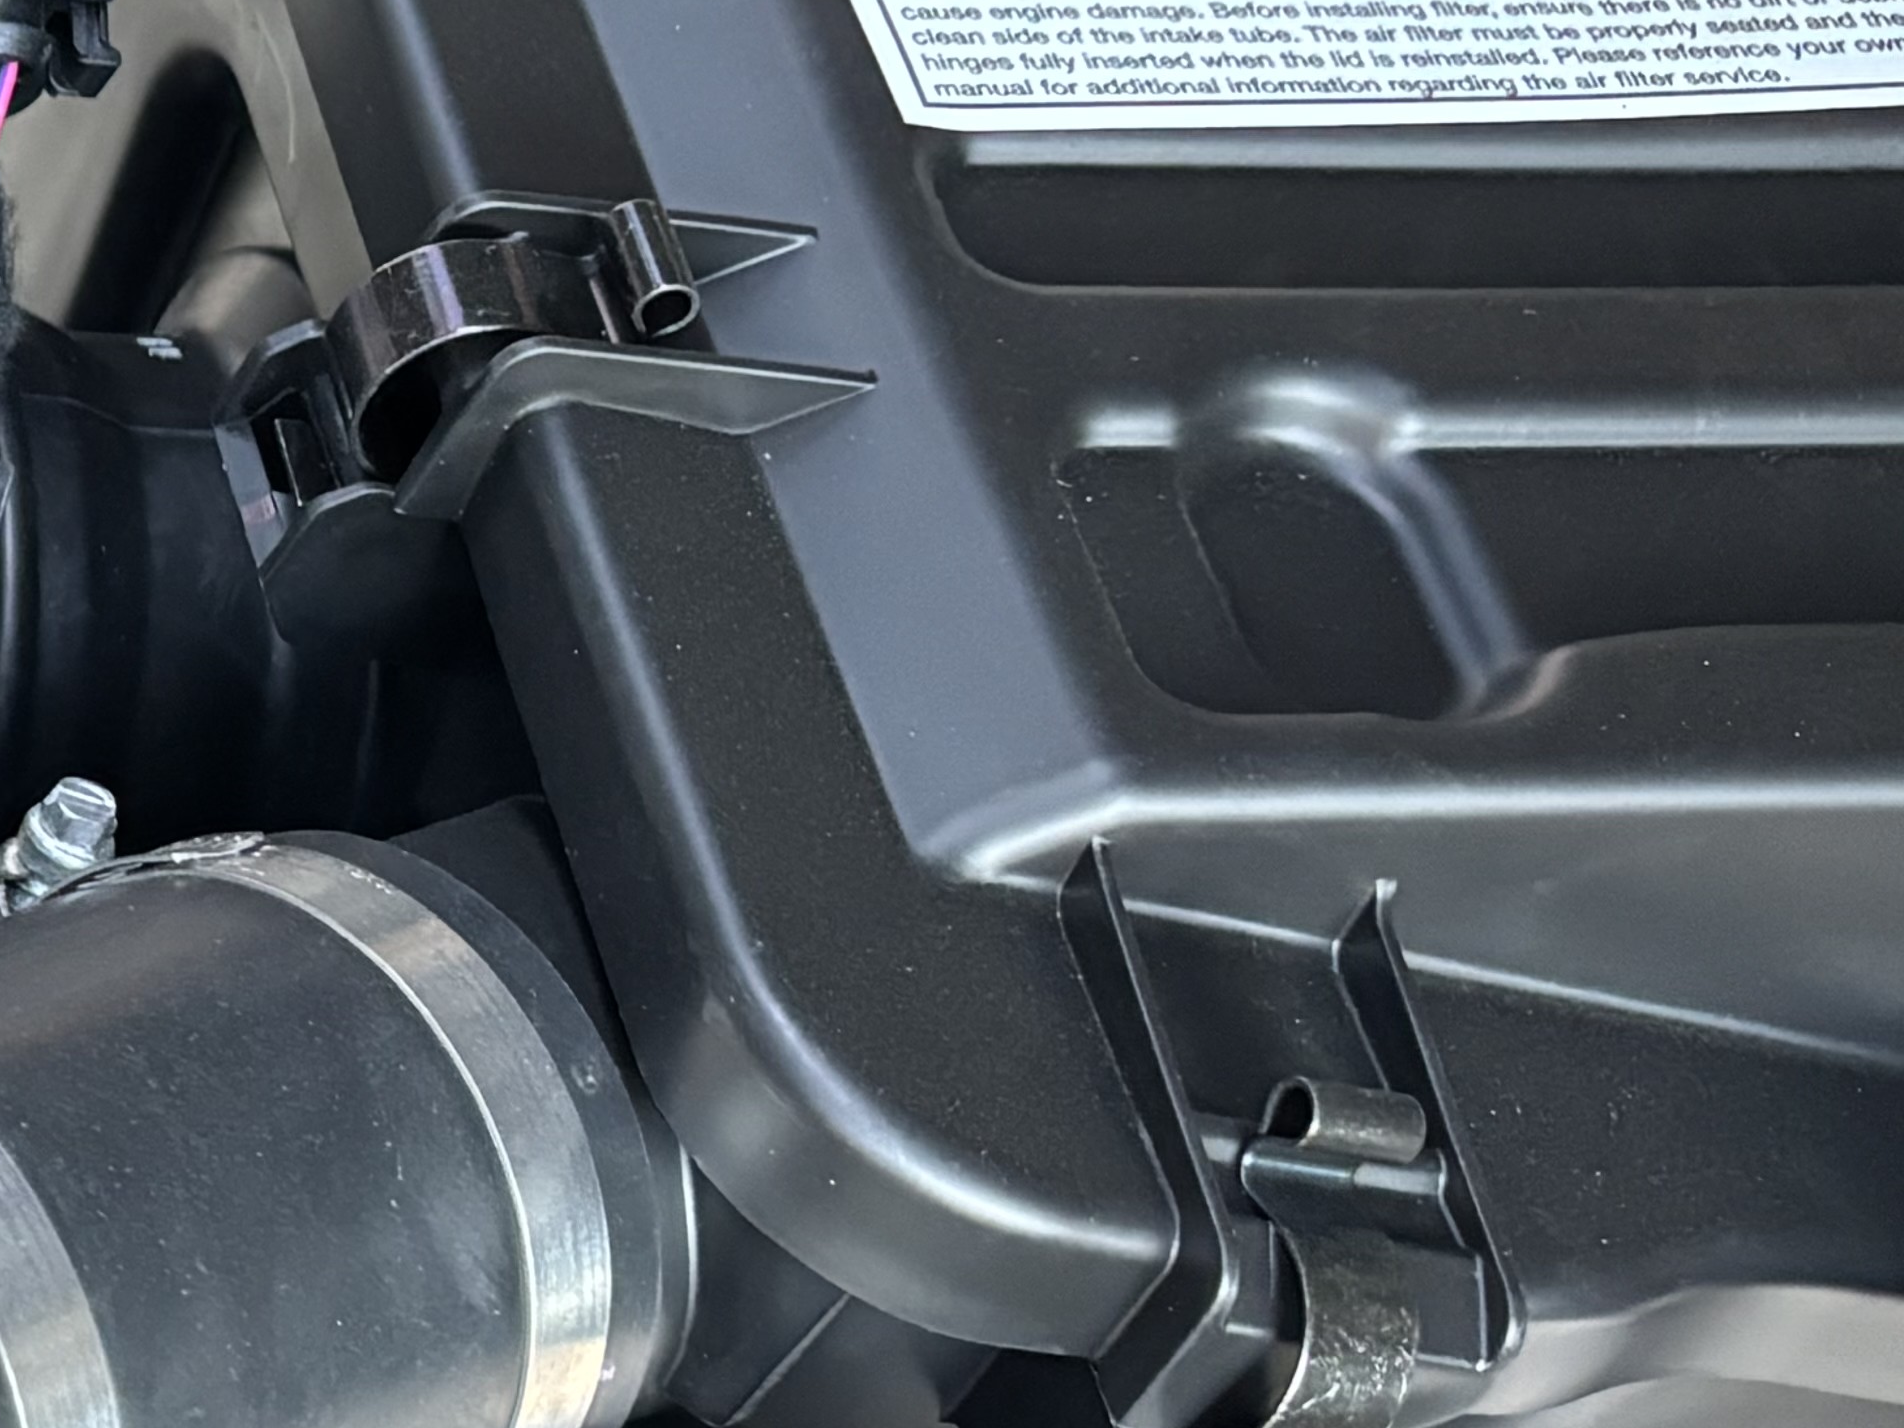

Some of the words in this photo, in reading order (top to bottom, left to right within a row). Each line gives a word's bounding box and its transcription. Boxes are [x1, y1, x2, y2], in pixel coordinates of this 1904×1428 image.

[901, 4, 982, 21] cause
[989, 3, 1080, 23] engine
[1087, 2, 1204, 23] damage.
[1208, 1, 1300, 19] Before
[1305, 0, 1426, 21] installing
[1431, 0, 1498, 19] filter,
[1504, 0, 1593, 17] ensure
[912, 28, 986, 46] clean
[992, 28, 1049, 45] side
[1057, 27, 1084, 44] of
[1091, 27, 1135, 44] the
[1141, 26, 1224, 44] intake
[1229, 26, 1301, 43] tube.
[1302, 25, 1358, 43] The
[1365, 24, 1396, 42] air
[1403, 24, 1463, 42] filter
[1472, 24, 1539, 41] must
[1545, 21, 1580, 39] be
[1587, 19, 1697, 40] properly
[1706, 14, 1798, 34] seated
[1805, 11, 1858, 30] and
[1861, 9, 1904, 27] the
[920, 52, 1015, 74] hinges
[1019, 52, 1075, 74] fully
[1082, 51, 1194, 70] inserted
[1201, 51, 1275, 69] when
[1280, 50, 1325, 68] the
[1330, 50, 1365, 68] lid
[1369, 49, 1395, 67] is
[1401, 47, 1548, 67] reinstalled.
[1555, 45, 1646, 64] Please
[1652, 42, 1781, 62] reference
[1786, 39, 1845, 61] your
[933, 79, 1033, 97] manual
[1041, 79, 1078, 95] for
[1086, 77, 1220, 95] additional
[1226, 76, 1381, 95] information
[1389, 74, 1517, 99] regarding
[1522, 73, 1567, 91] the
[1575, 71, 1607, 89] air
[1614, 70, 1676, 88] filter
[1686, 67, 1790, 86] service.
